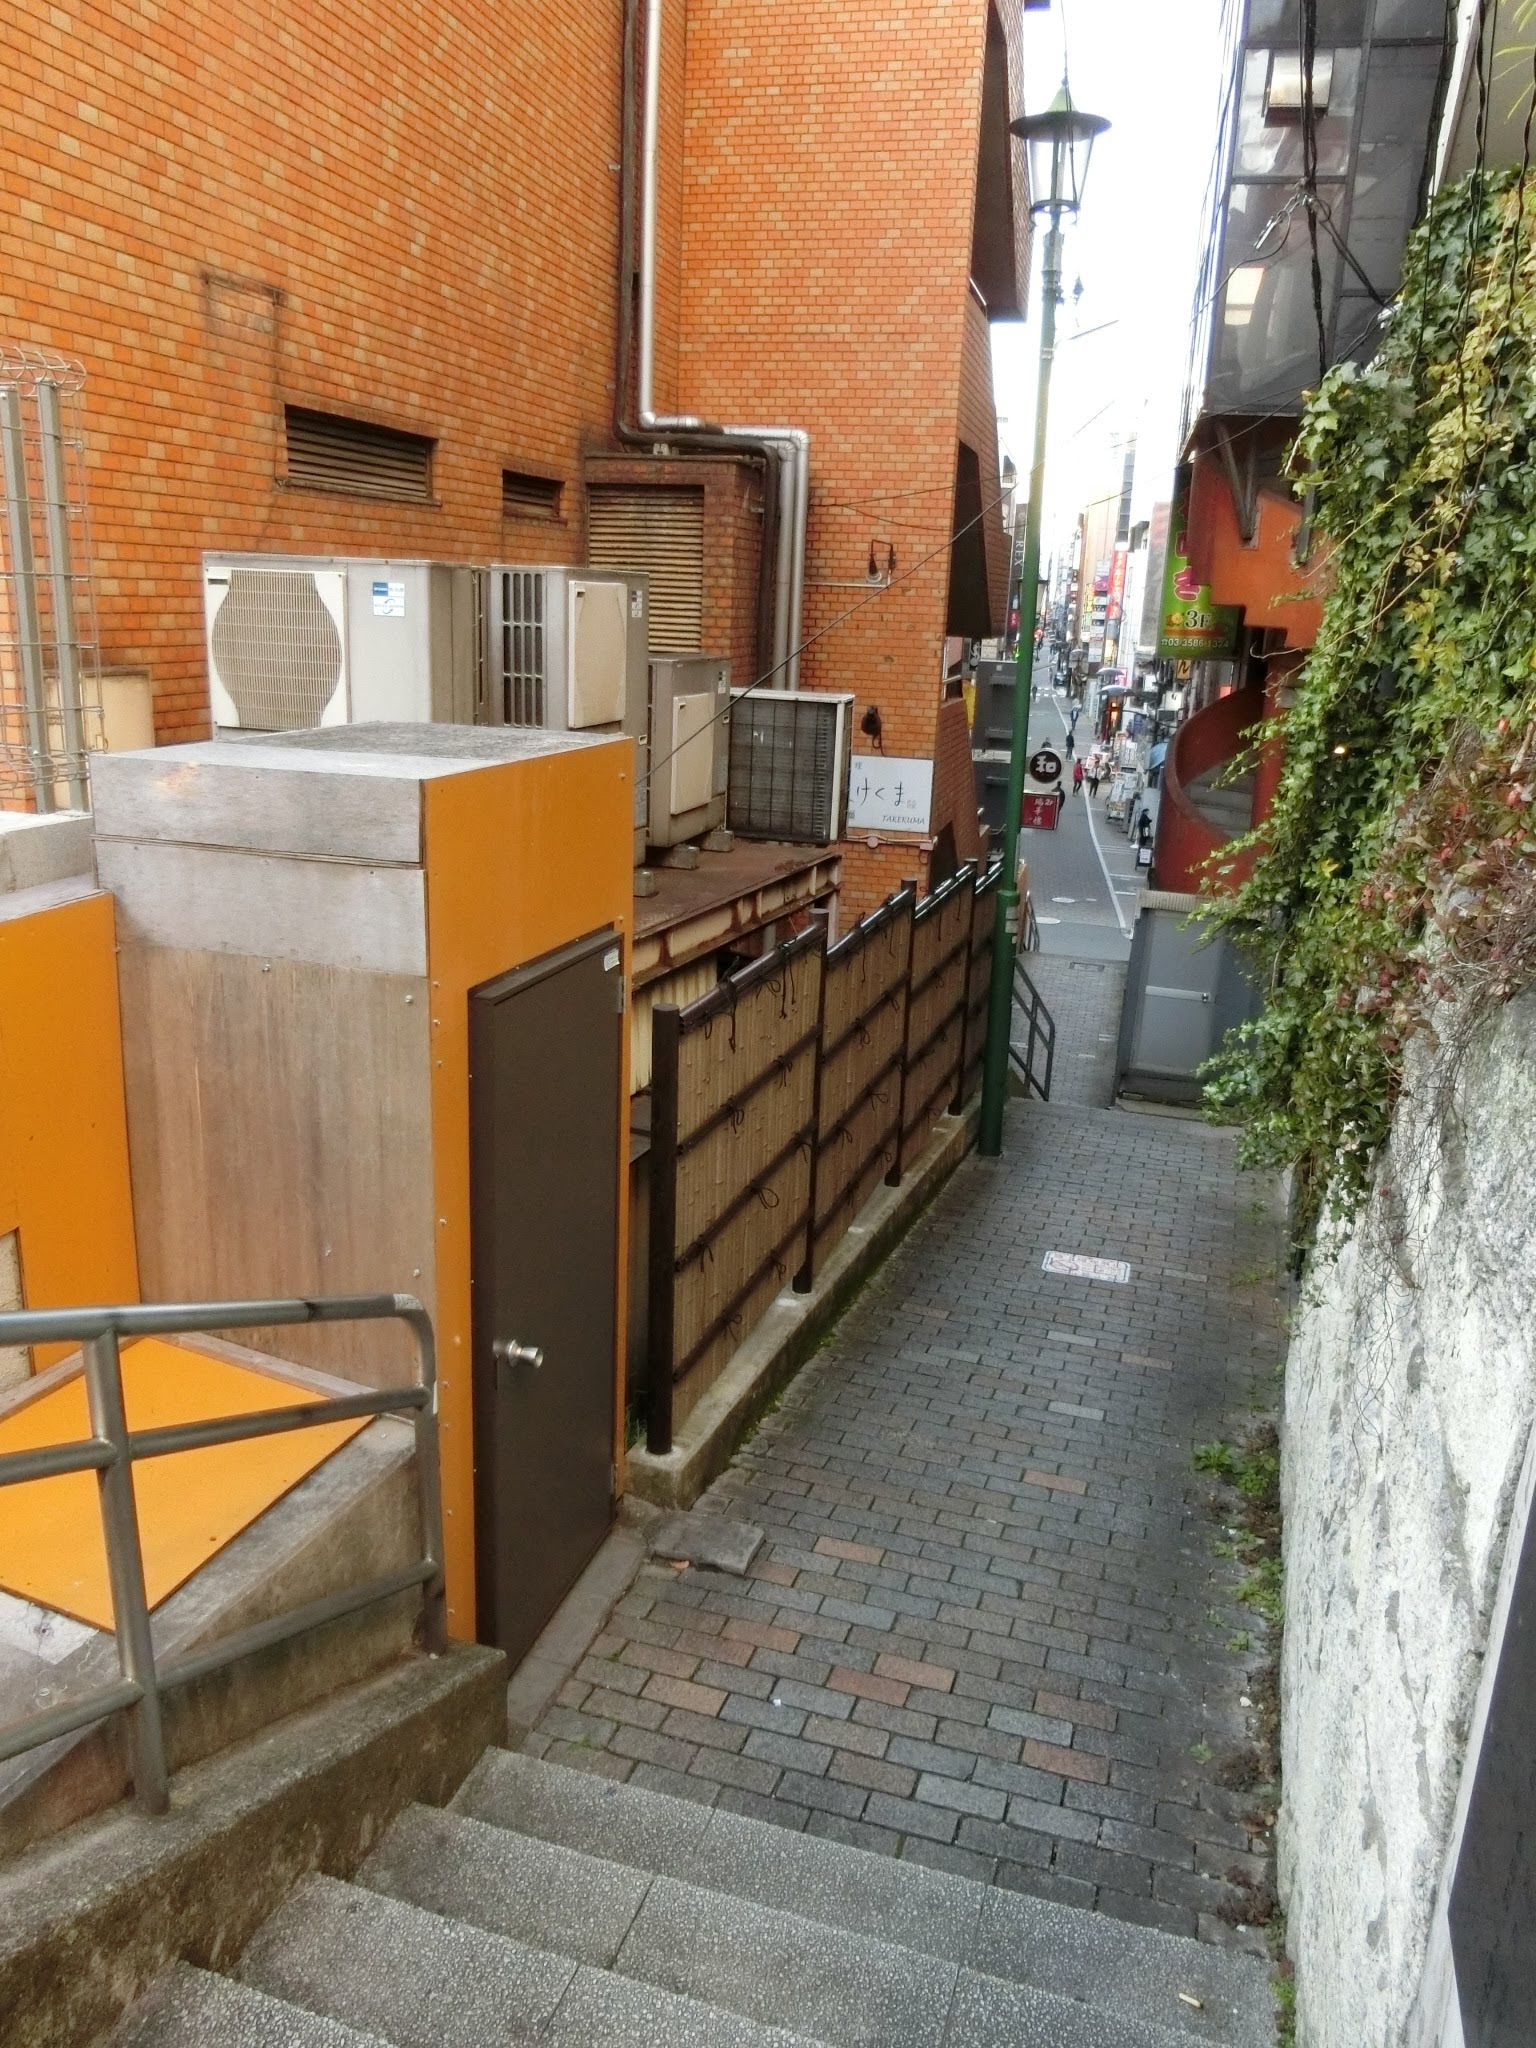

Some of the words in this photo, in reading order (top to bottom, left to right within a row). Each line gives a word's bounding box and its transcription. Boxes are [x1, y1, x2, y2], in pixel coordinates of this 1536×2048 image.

[1184, 609, 1211, 628] 3F
[1035, 755, 1057, 773] 和
[850, 777, 906, 807] けくま
[882, 815, 925, 825] TAKEKUMA
